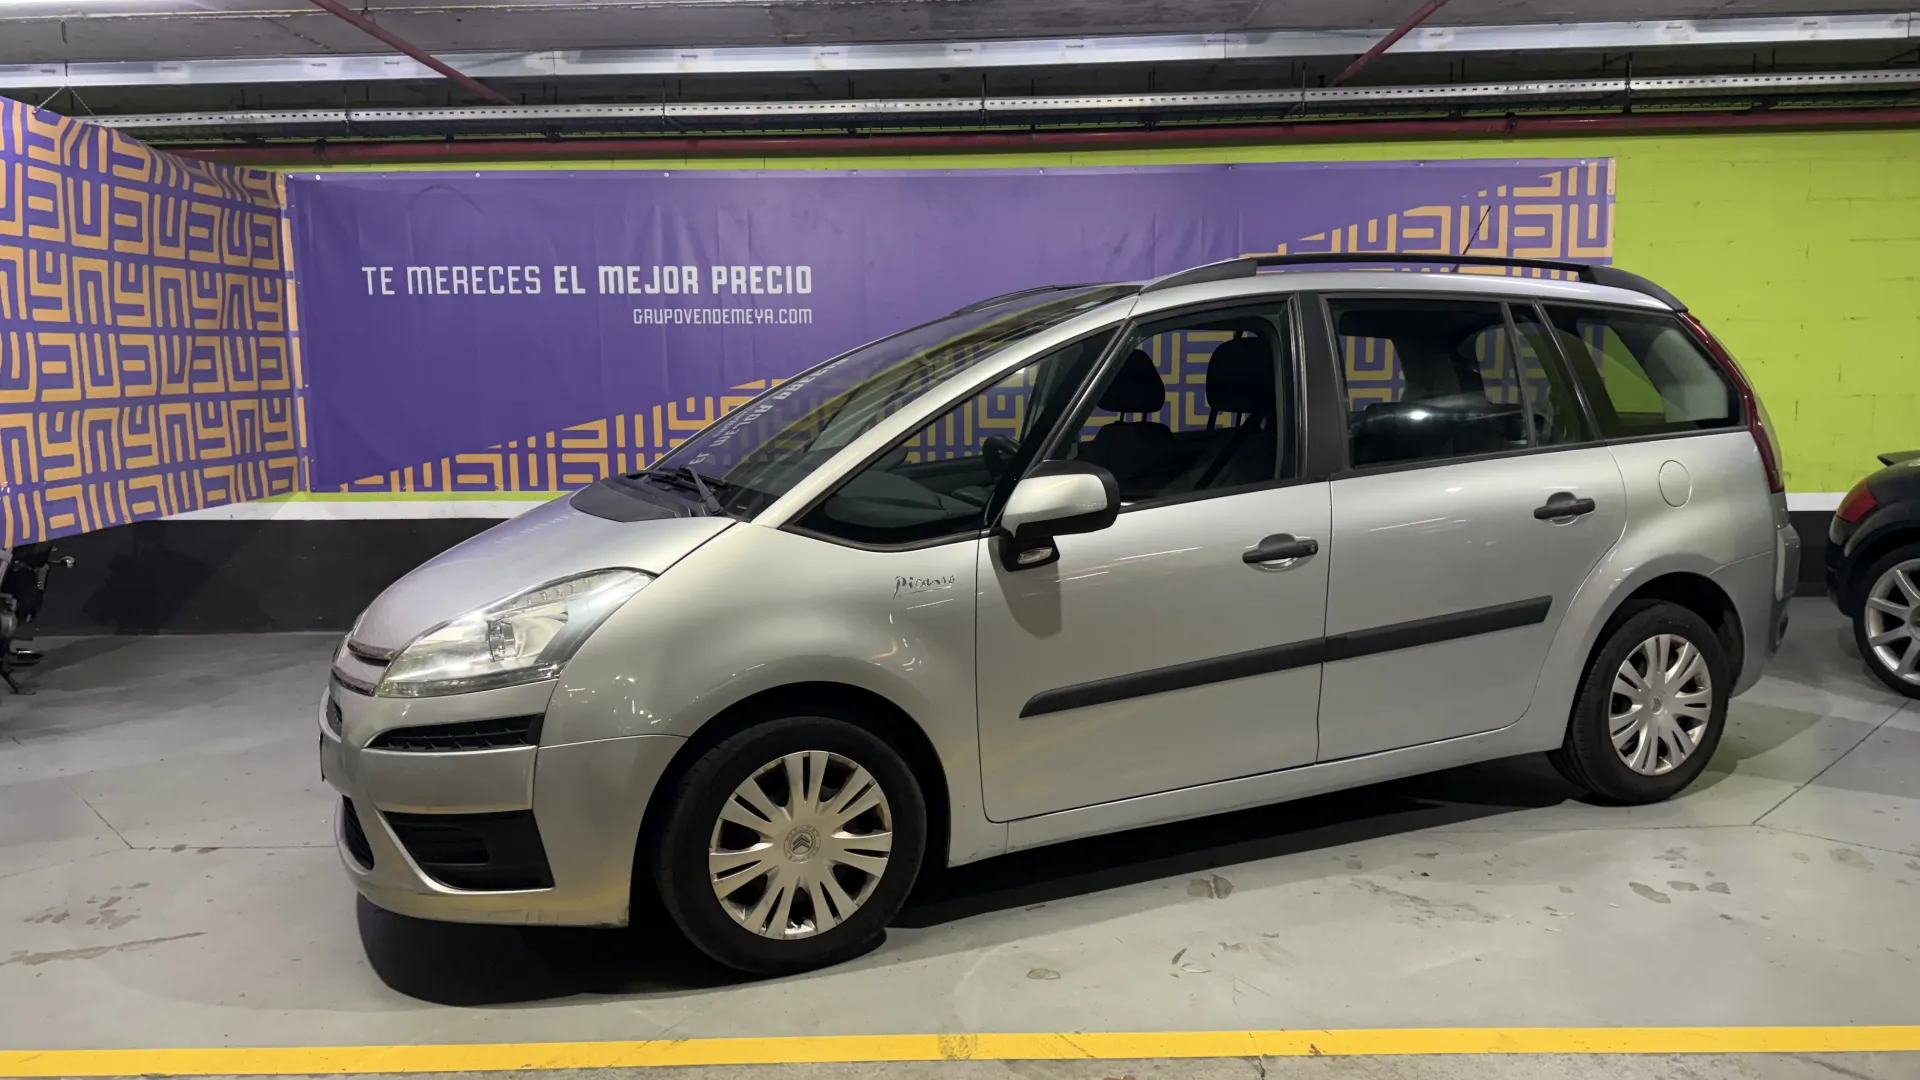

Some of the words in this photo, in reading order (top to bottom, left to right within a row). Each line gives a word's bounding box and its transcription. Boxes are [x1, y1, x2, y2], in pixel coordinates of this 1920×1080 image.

[361, 266, 395, 295] TE
[406, 265, 541, 295] MERECES
[553, 265, 586, 294] EL
[598, 265, 699, 295] MEJOR
[711, 265, 812, 295] PRECIO
[633, 308, 813, 325] GRUPOVENDEMEYA.COM
